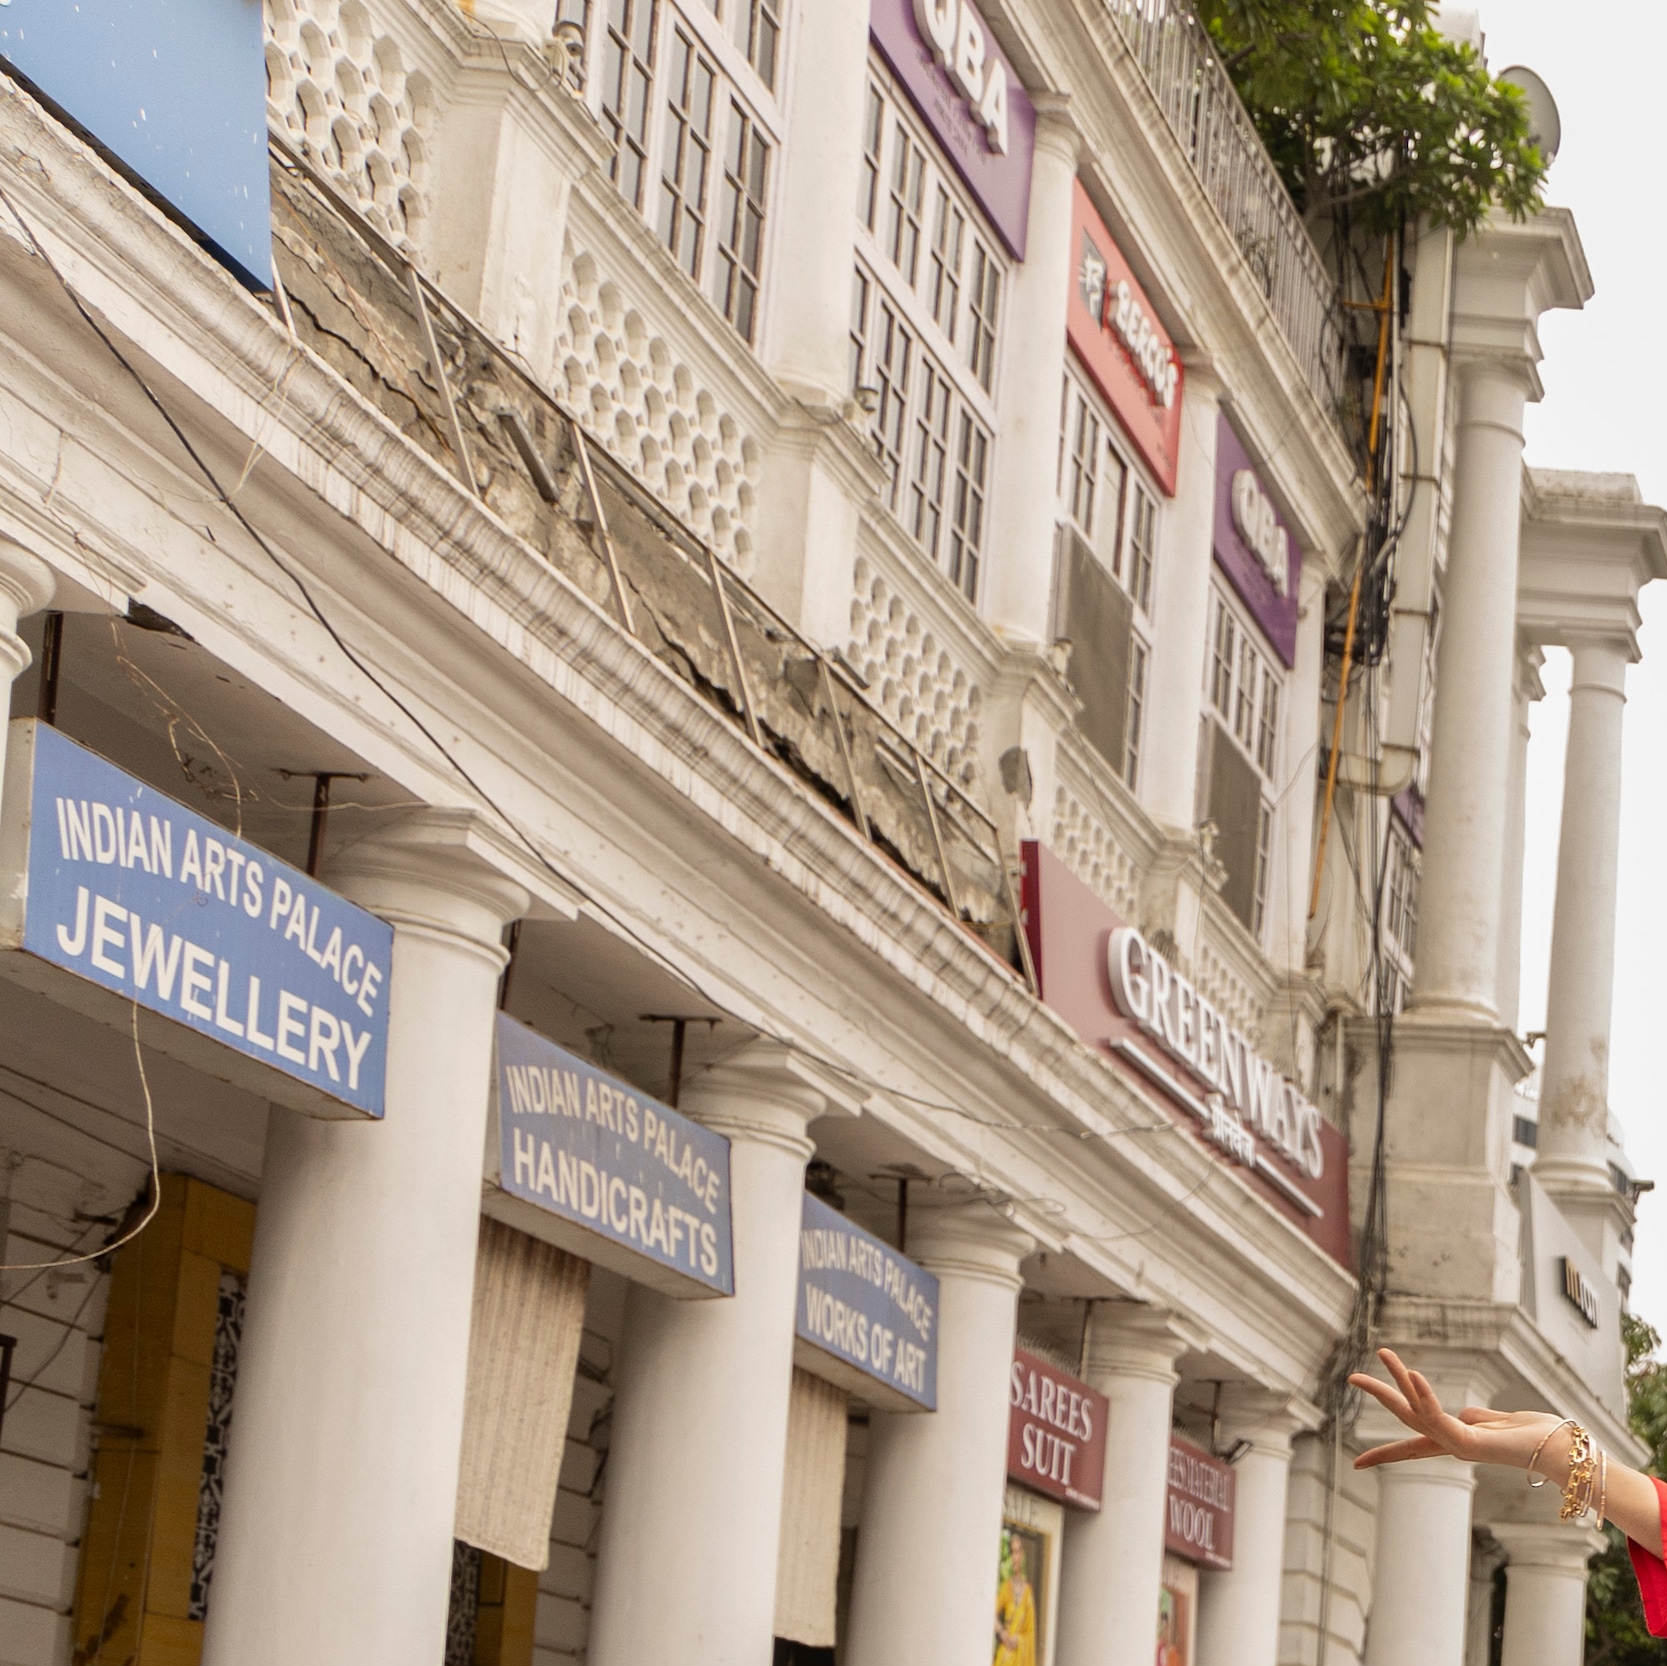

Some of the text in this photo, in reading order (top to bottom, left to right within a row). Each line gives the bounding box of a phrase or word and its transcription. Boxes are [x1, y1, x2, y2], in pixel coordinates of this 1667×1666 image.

[56, 797, 383, 1018] INDIAN ARTS PALACE
[56, 885, 372, 1091] JEWELLERY
[1109, 926, 1323, 1180] GREENWAYS
[505, 1065, 721, 1215] INDIAN ARTS PALACE
[513, 1126, 719, 1278] HANDICRAFTS
[805, 1282, 927, 1393] WORKS OF ART
[849, 1235, 883, 1288] ARTS
[884, 1256, 933, 1342] PALACE
[1010, 1360, 1094, 1443] SAREES
[1021, 1422, 1077, 1486] SUIT
[1169, 1494, 1216, 1552] WOOL
